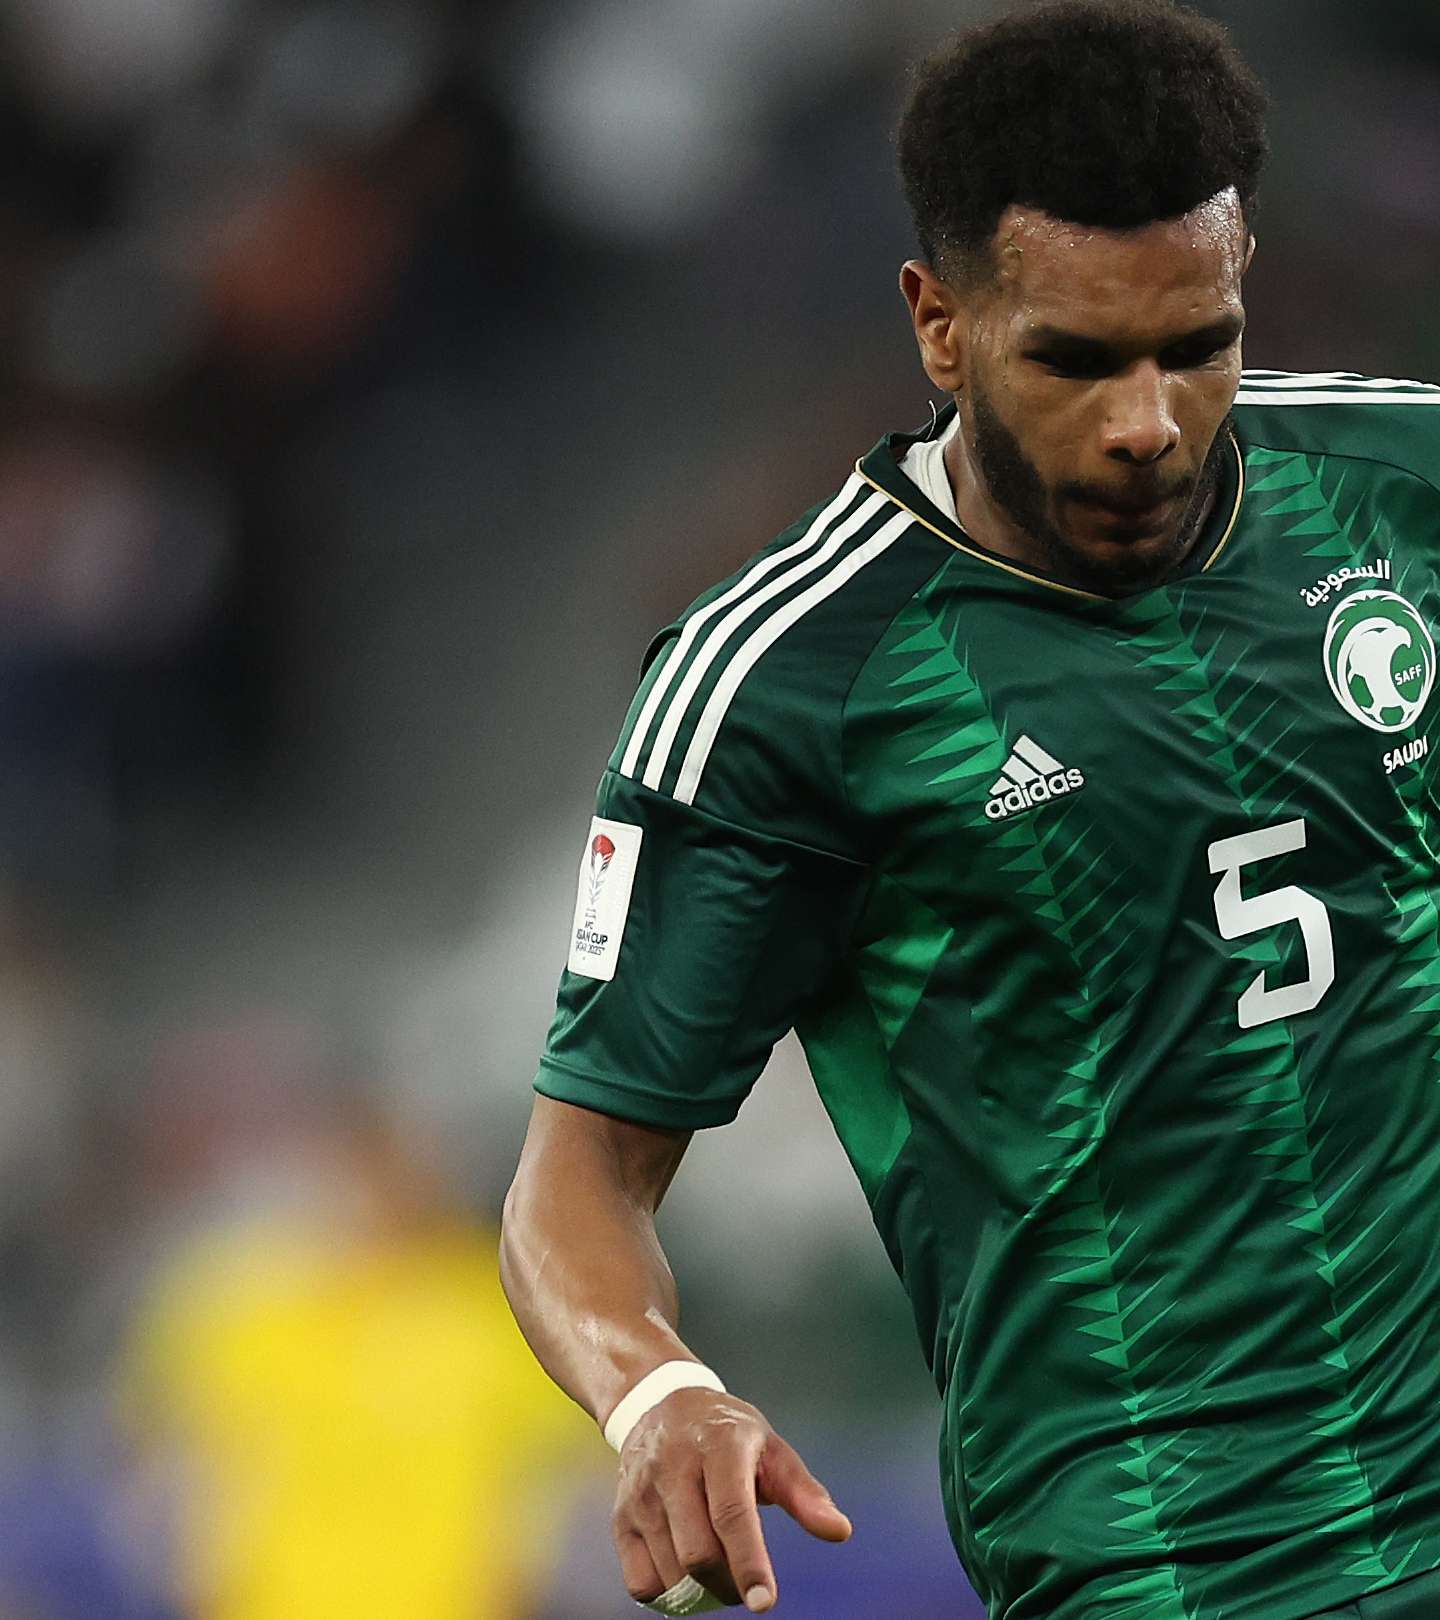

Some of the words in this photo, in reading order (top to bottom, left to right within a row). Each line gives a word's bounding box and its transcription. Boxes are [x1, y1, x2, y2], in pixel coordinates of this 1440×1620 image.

[1300, 559, 1390, 607] السعودية
[1394, 664, 1422, 686] SAFF
[1383, 736, 1428, 775] SAUDI
[984, 768, 1084, 819] adidas
[591, 932, 608, 945] CUP
[1207, 818, 1335, 1029] 5
